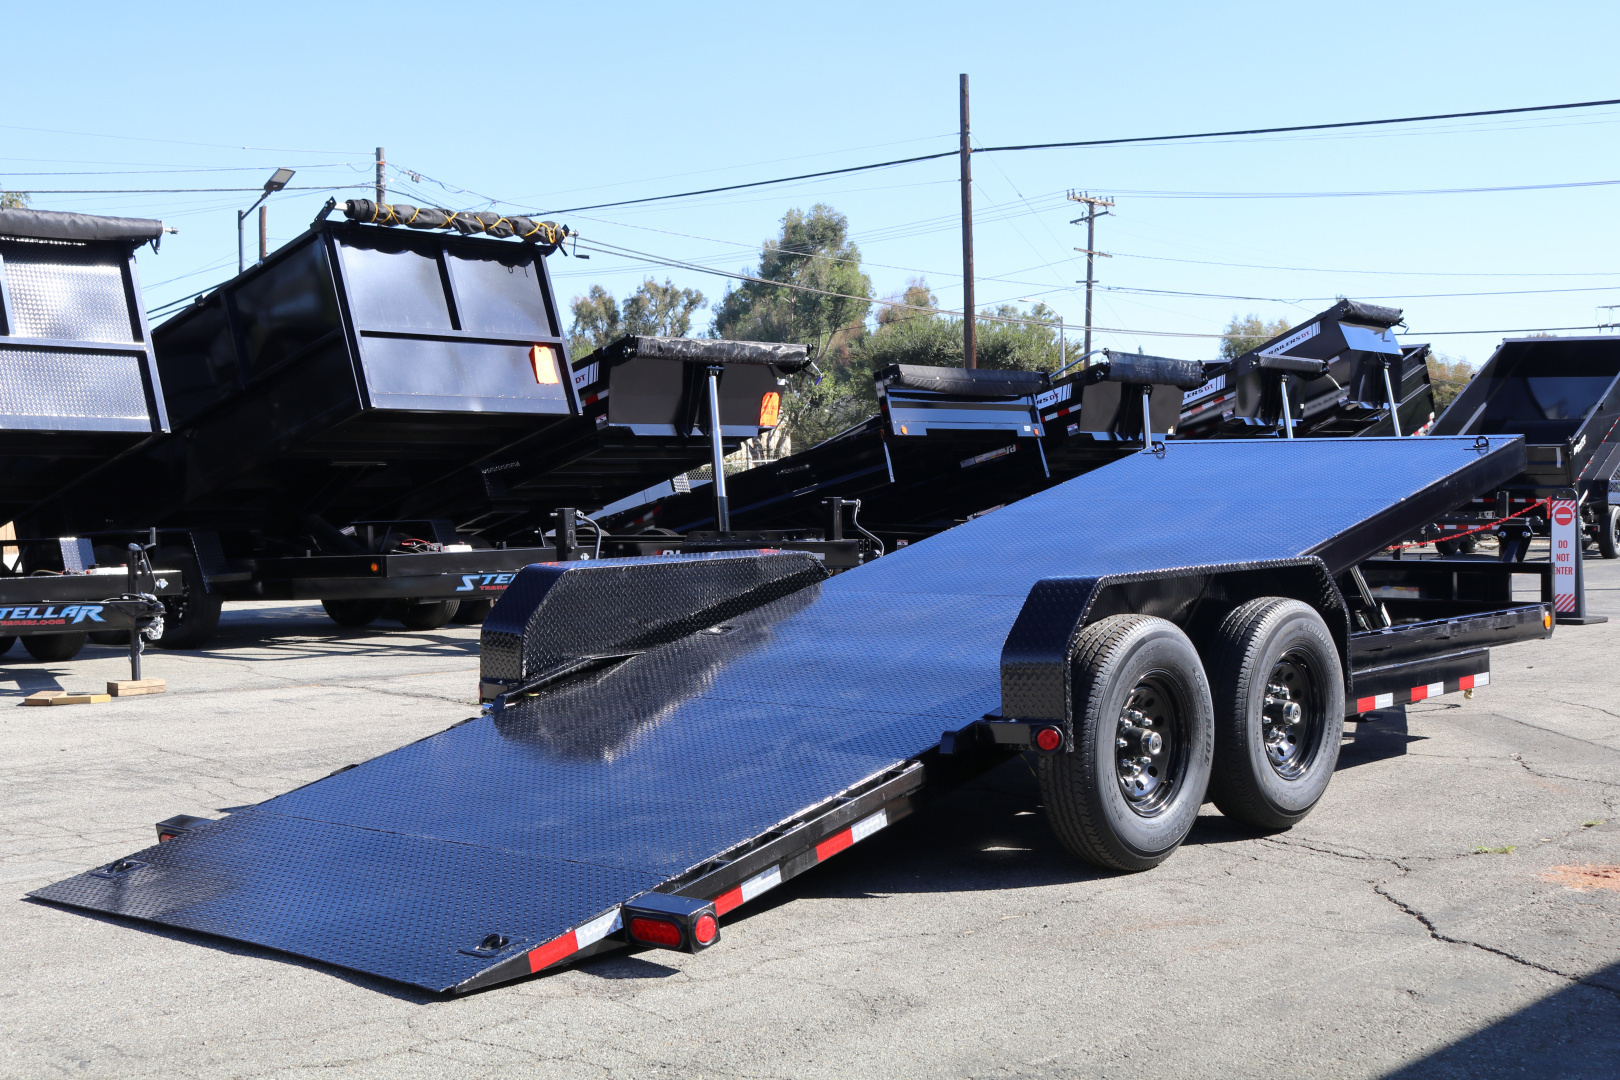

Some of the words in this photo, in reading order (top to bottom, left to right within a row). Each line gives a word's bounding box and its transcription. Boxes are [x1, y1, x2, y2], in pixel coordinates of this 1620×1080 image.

[575, 373, 586, 384] DT
[1204, 383, 1214, 392] DT
[1558, 540, 1568, 548] DO
[1556, 553, 1570, 562] NOT
[0, 605, 107, 625] TELLAR
